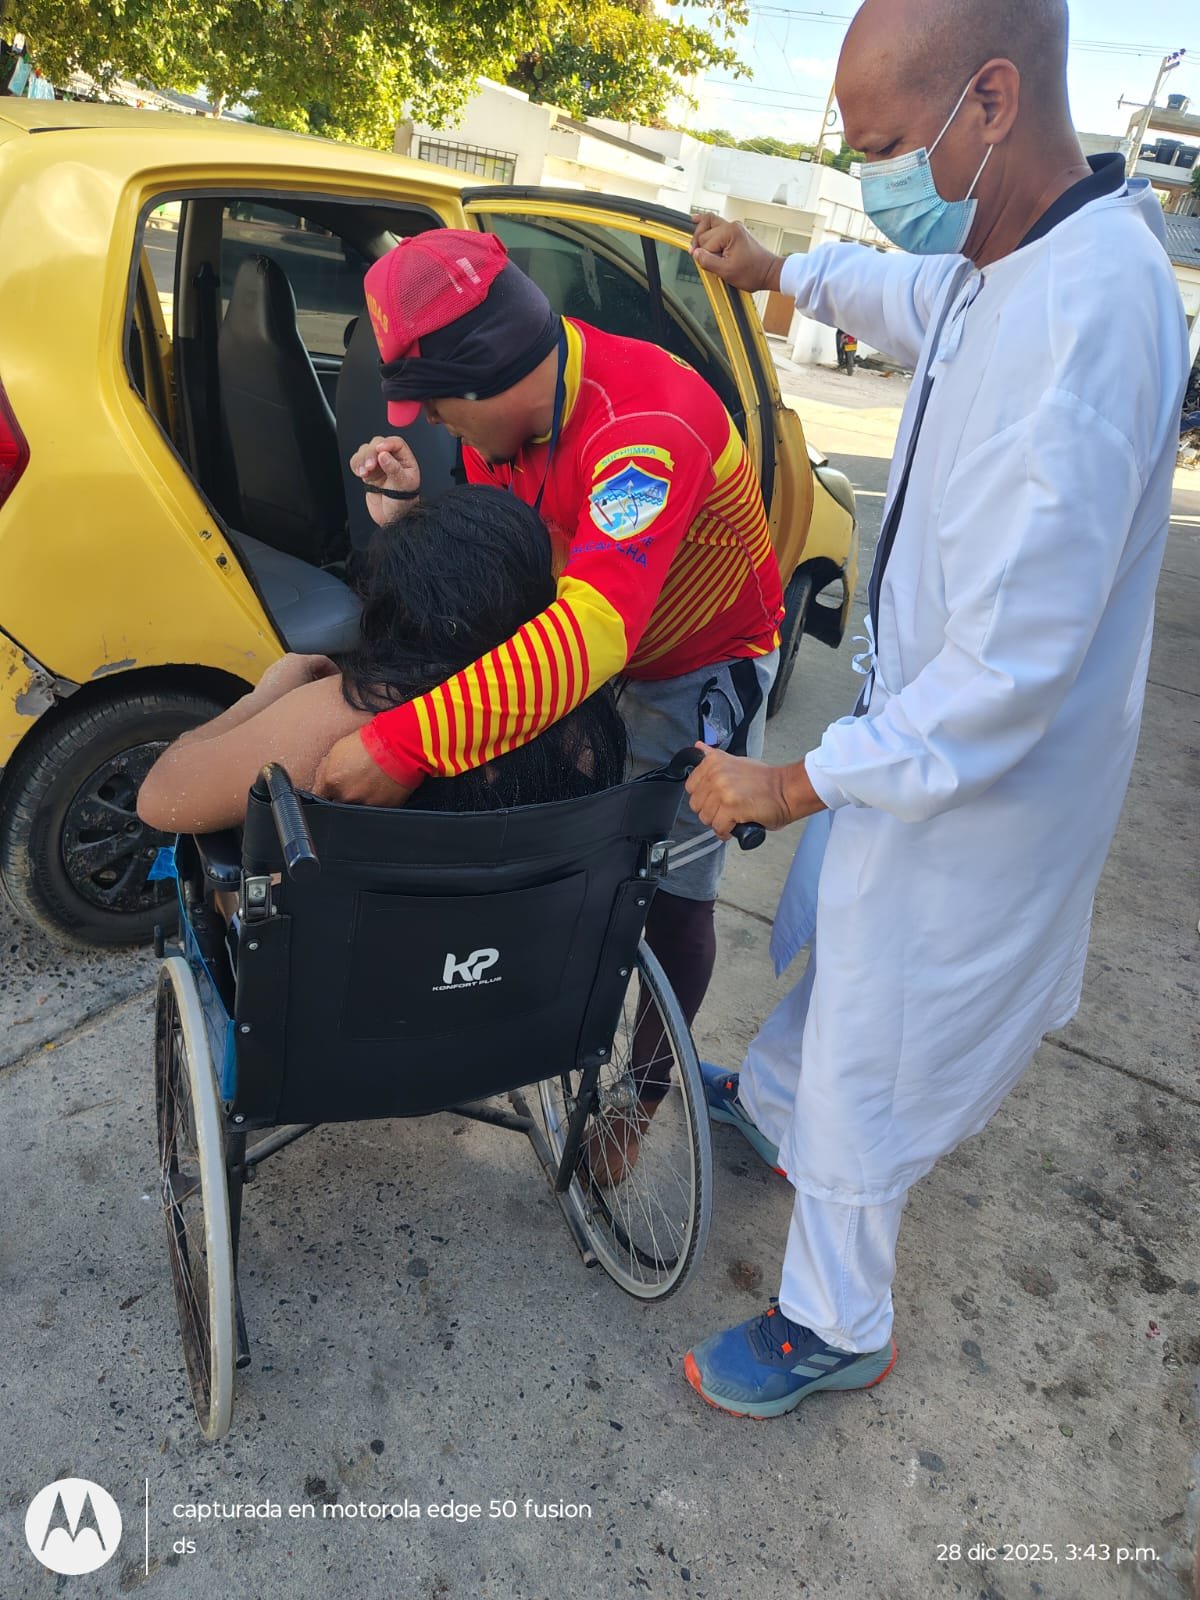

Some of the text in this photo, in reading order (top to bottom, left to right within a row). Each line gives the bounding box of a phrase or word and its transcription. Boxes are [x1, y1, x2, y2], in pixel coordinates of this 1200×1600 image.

[442, 947, 500, 985] KP
[432, 976, 502, 991] KONFORT PLUS
